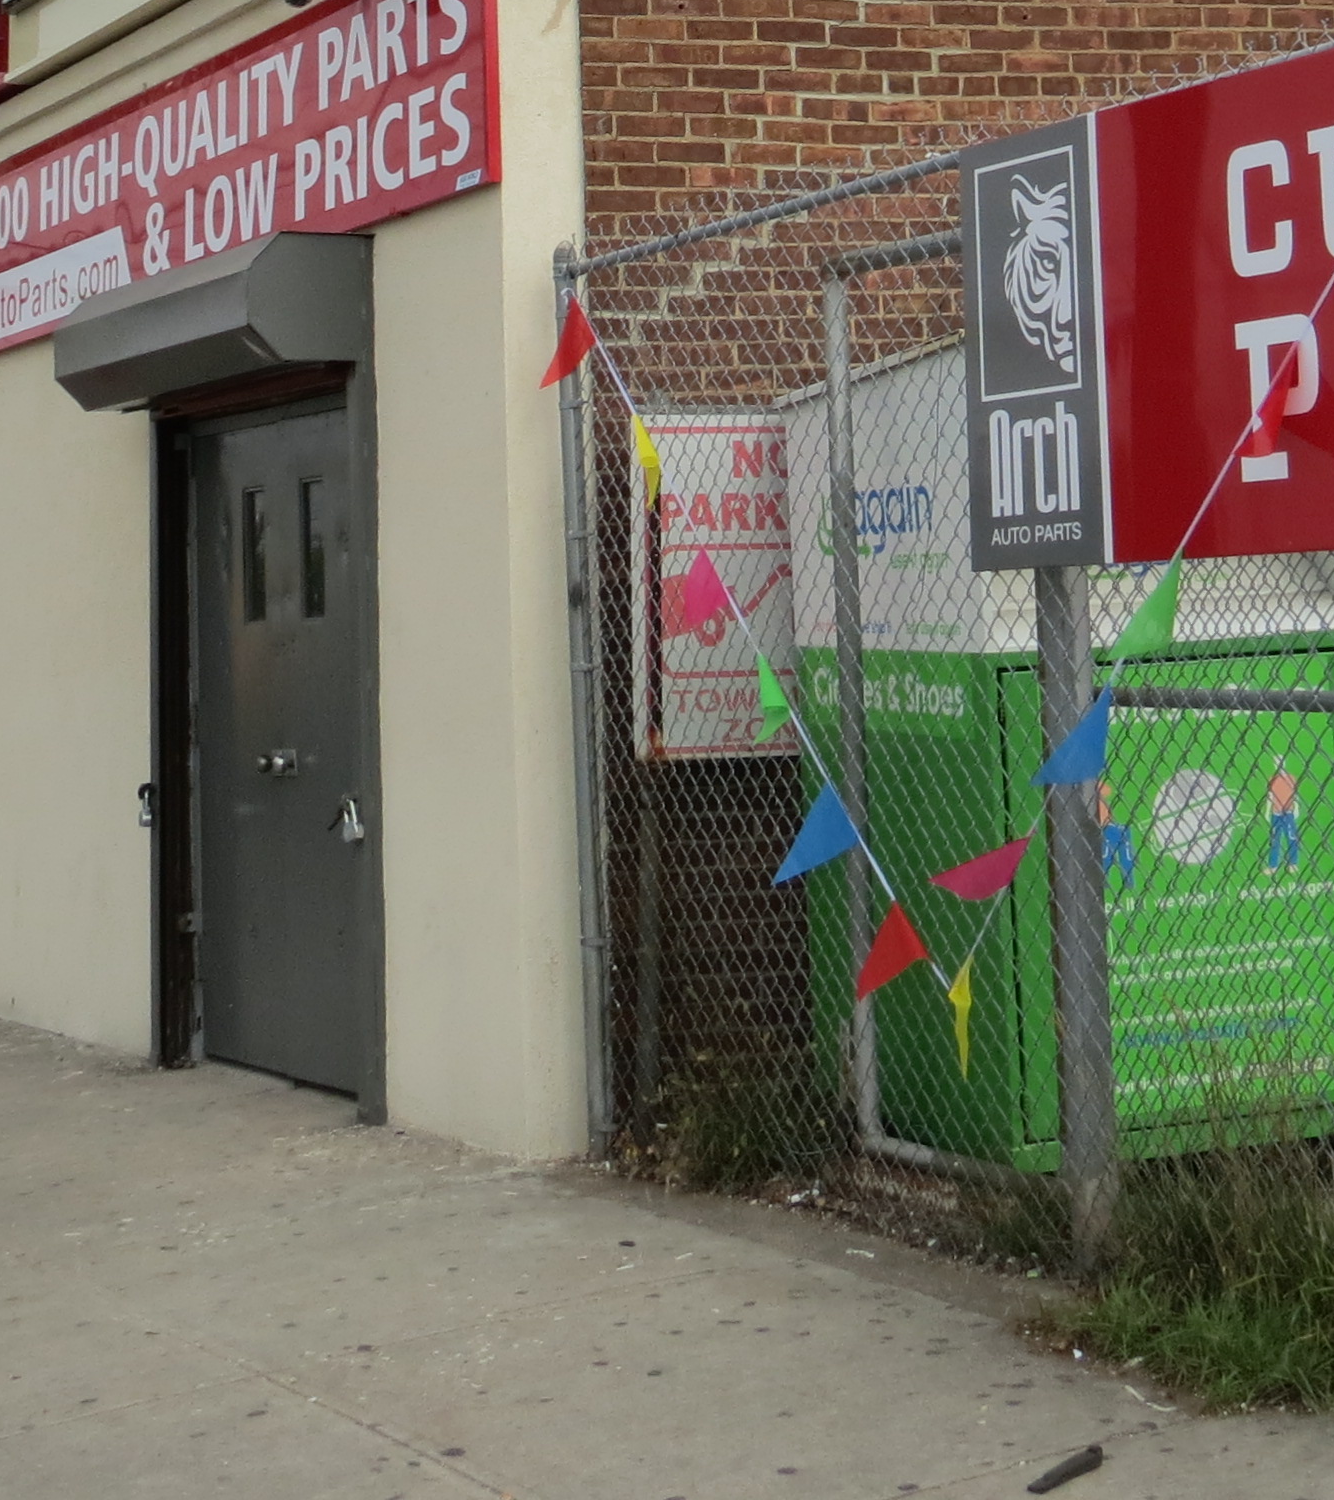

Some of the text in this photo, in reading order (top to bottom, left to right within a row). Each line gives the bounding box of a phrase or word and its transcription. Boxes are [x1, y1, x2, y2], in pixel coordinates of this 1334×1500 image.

[39, 41, 304, 232] HIGH-QUALITY
[142, 72, 472, 278] & LOW PRICES
[660, 491, 789, 533] PARK
[988, 400, 1081, 518] Arch
[991, 521, 1083, 547] AUTO PARTS
